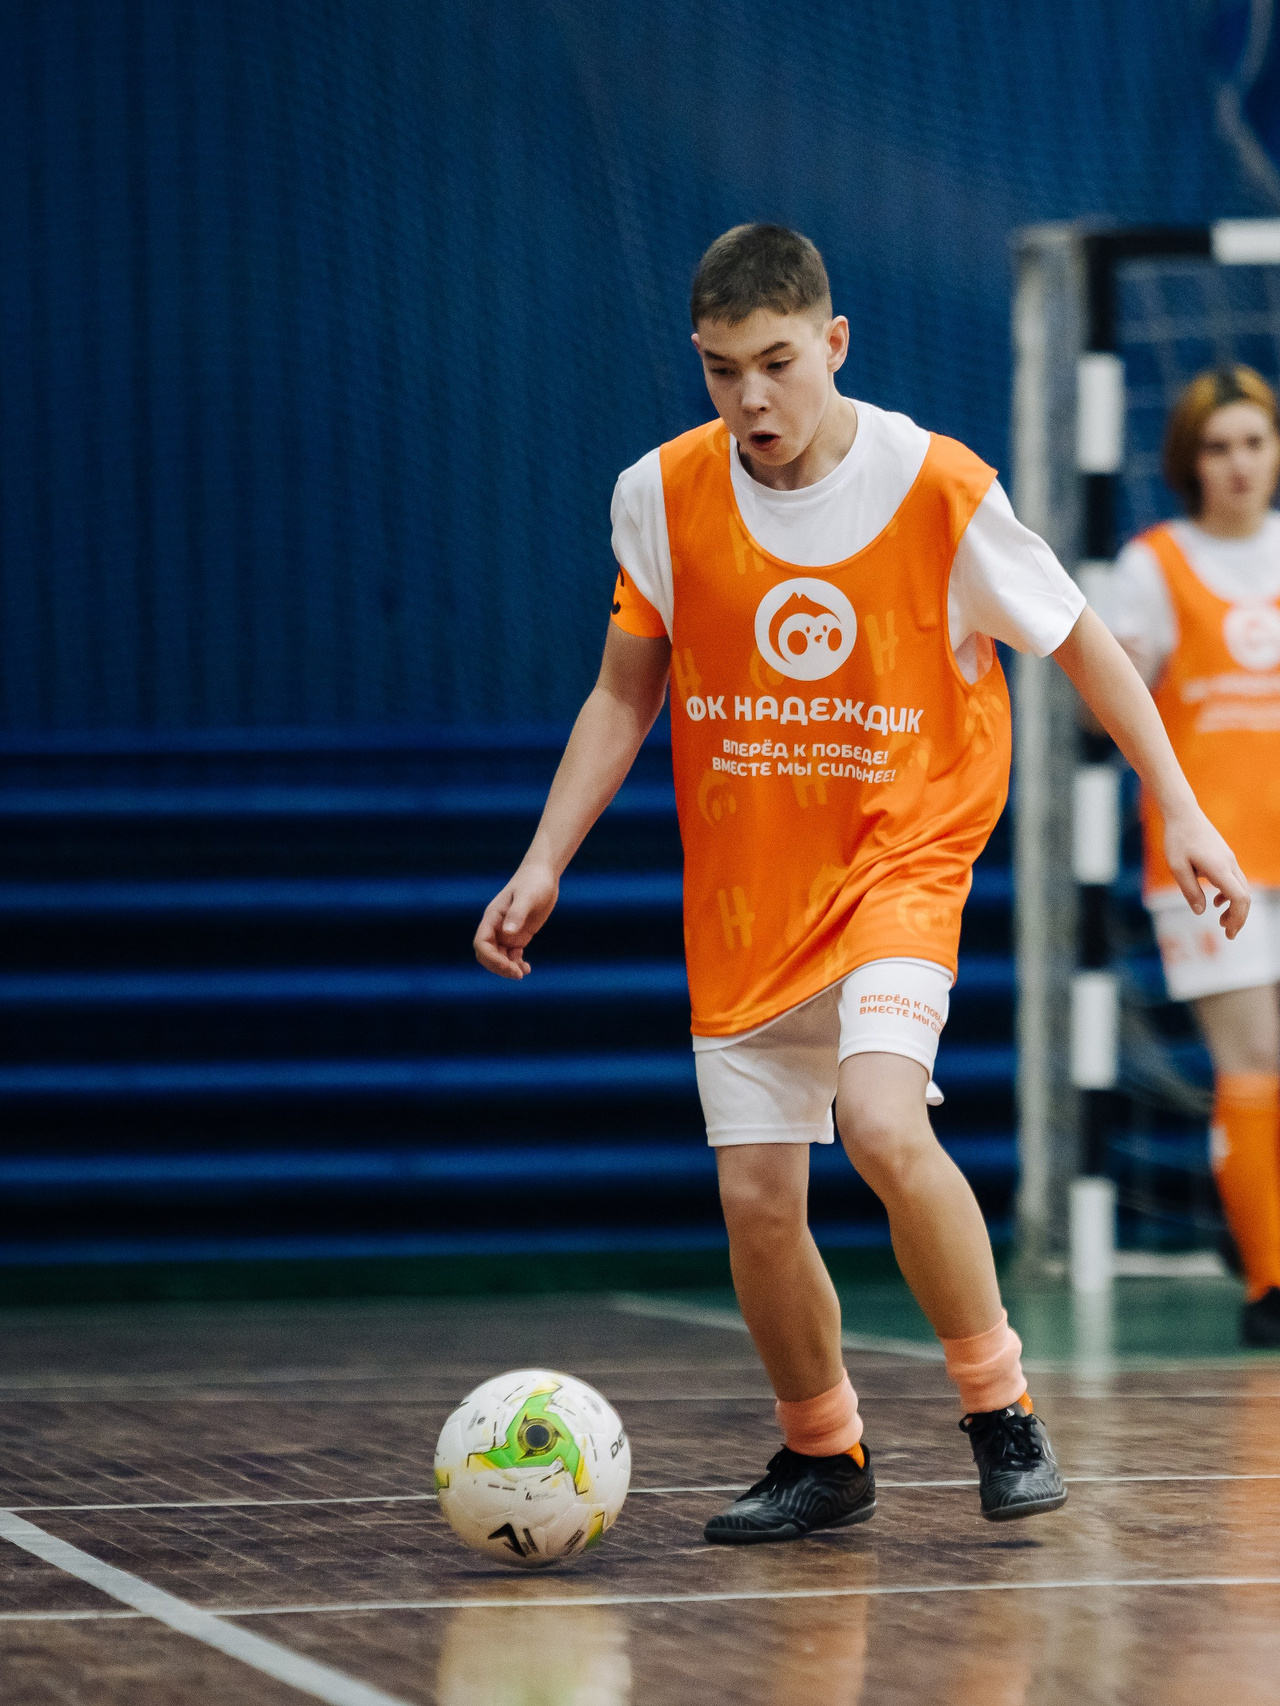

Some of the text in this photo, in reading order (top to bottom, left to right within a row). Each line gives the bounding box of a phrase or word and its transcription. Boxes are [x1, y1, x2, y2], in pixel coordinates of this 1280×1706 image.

[686, 695, 924, 736] ФК НАДЕЖДИК
[722, 738, 889, 766] ВПЕРЁД К ПОБЕДЕ!
[712, 756, 896, 784] ВМЕСТЕ МЫ СИЛЬНЕЕ!
[859, 1005, 910, 1018] ВМЕСТЕ
[912, 1012, 930, 1026] МЫ
[861, 994, 910, 1008] ВПЕРЁД
[914, 1001, 921, 1010] К
